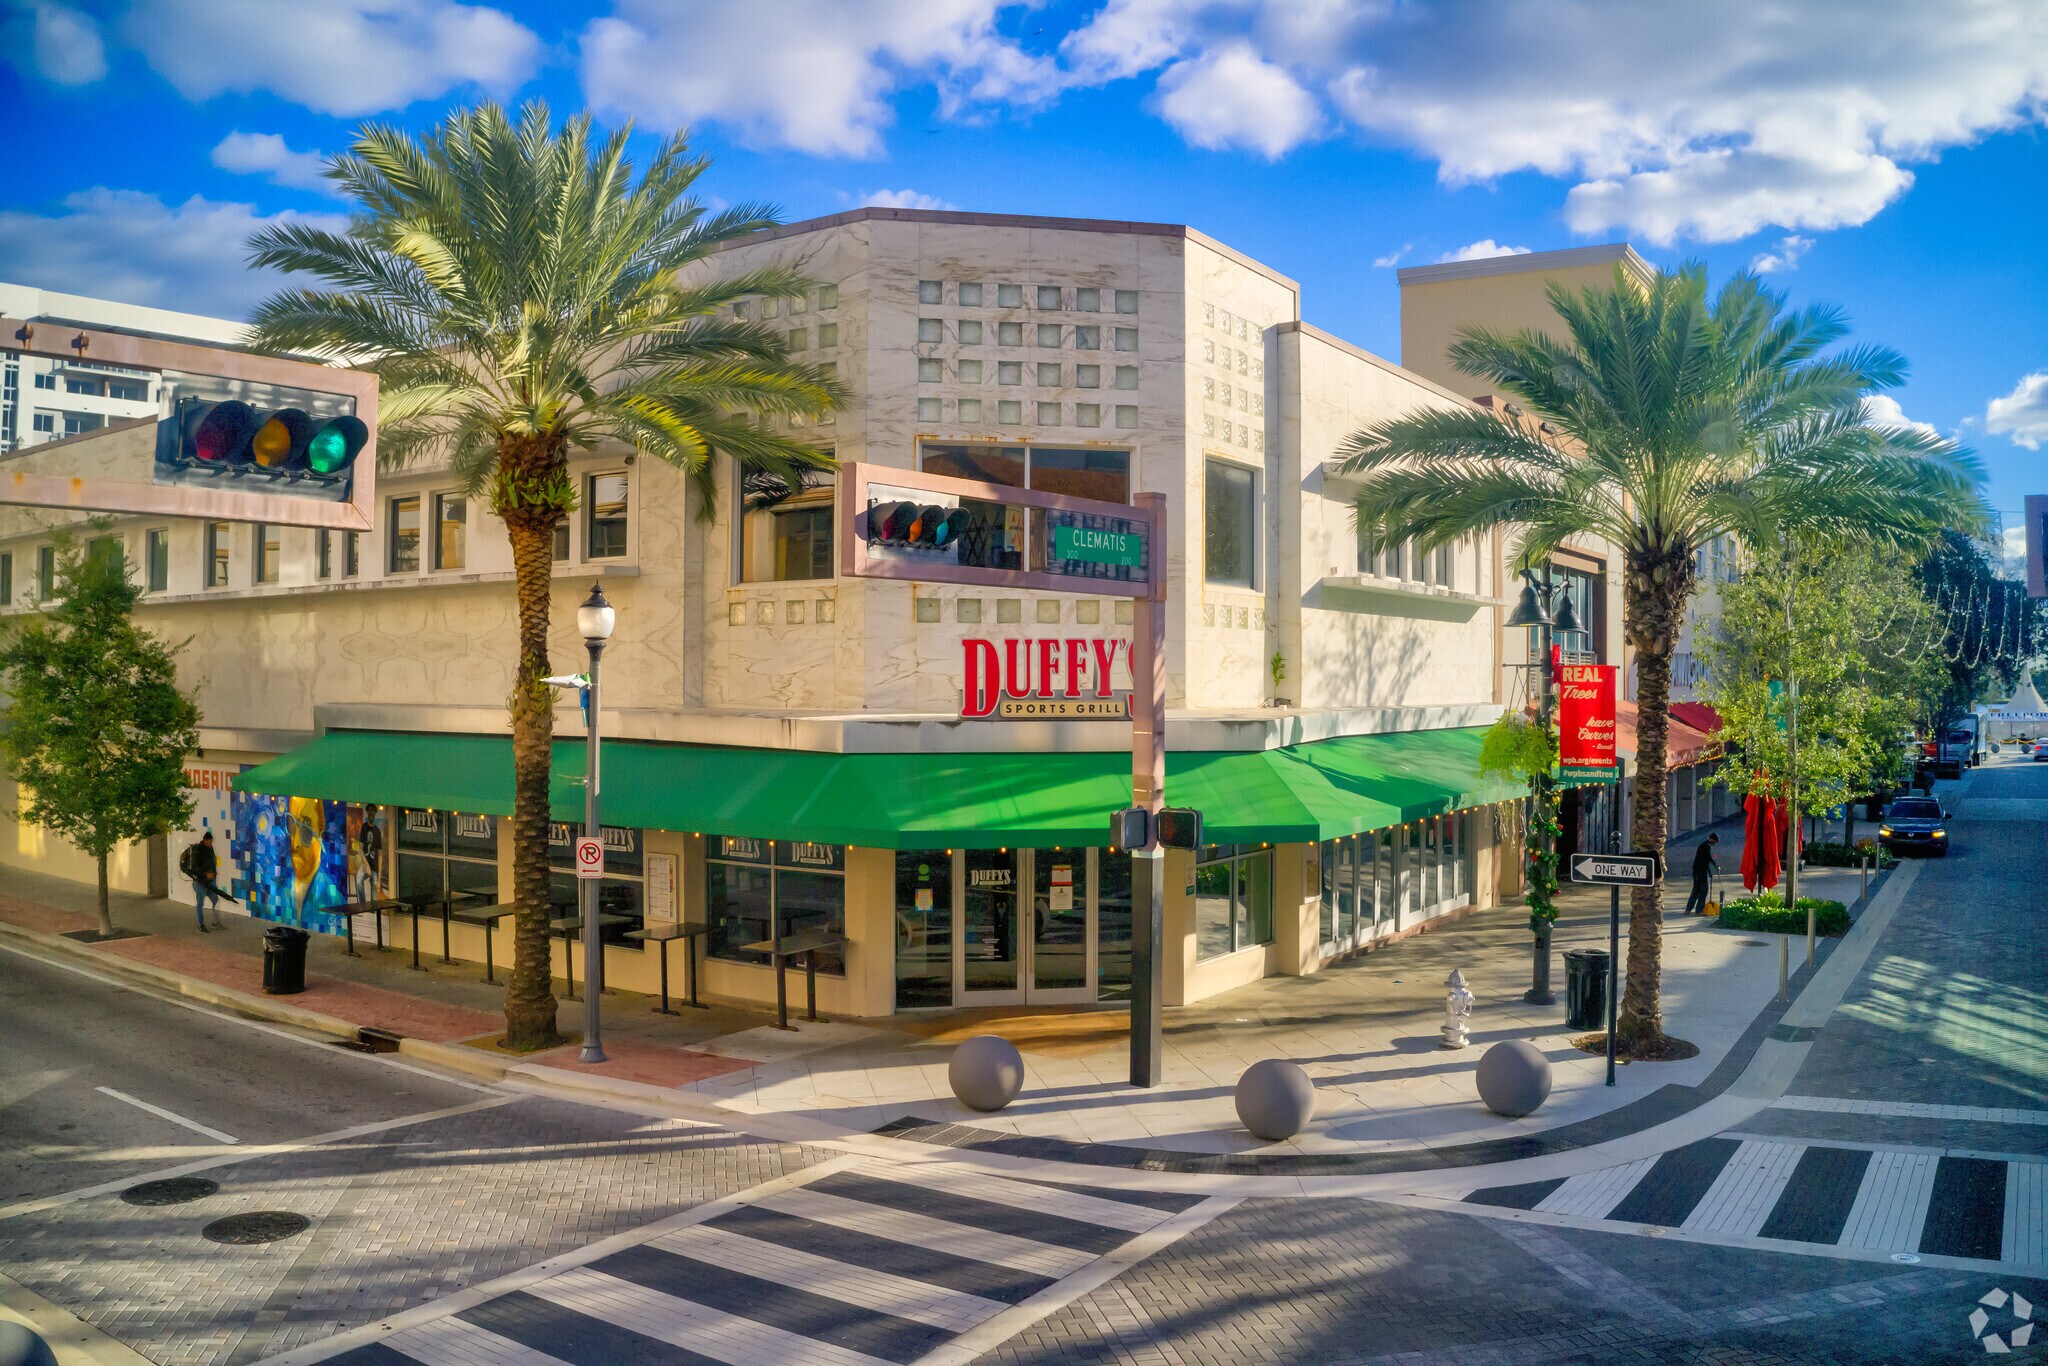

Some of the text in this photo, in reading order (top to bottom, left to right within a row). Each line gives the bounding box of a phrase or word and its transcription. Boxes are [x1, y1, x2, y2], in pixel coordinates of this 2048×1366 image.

[1072, 529, 1126, 552] CLEMATIS
[1066, 549, 1132, 566] 300 200
[961, 638, 1134, 717] DUFFY'
[1562, 667, 1603, 683] REAL
[1562, 685, 1598, 700] Trees
[1005, 704, 1121, 714] SPORTS GRILL
[1586, 716, 1615, 728] have
[1577, 727, 1615, 741] Curves
[1562, 756, 1613, 766] wpb.org/events
[1562, 769, 1614, 779] #wpbsandtree
[1594, 864, 1643, 877] ONE WAY
